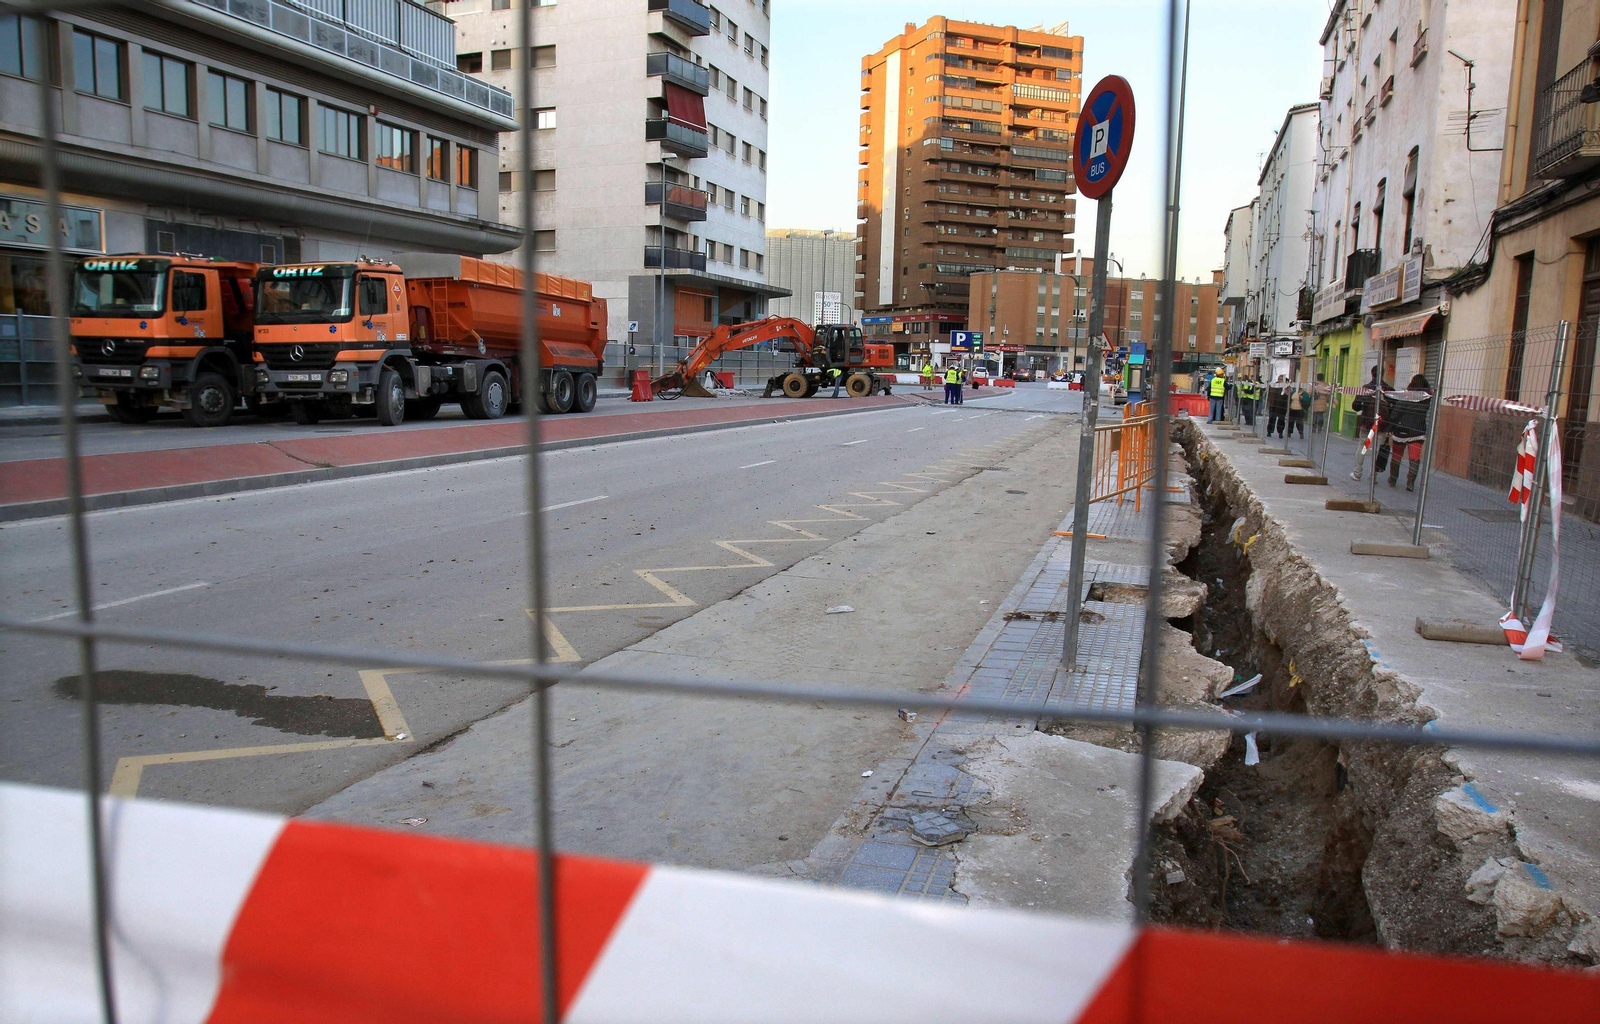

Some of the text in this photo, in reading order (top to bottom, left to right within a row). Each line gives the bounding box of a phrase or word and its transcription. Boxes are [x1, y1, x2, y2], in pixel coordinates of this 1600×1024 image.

[1095, 128, 1104, 153] P
[1090, 162, 1105, 177] BUS
[84, 259, 140, 271] ORTIZ
[273, 265, 325, 278] ORTIZ
[956, 332, 967, 346] P
